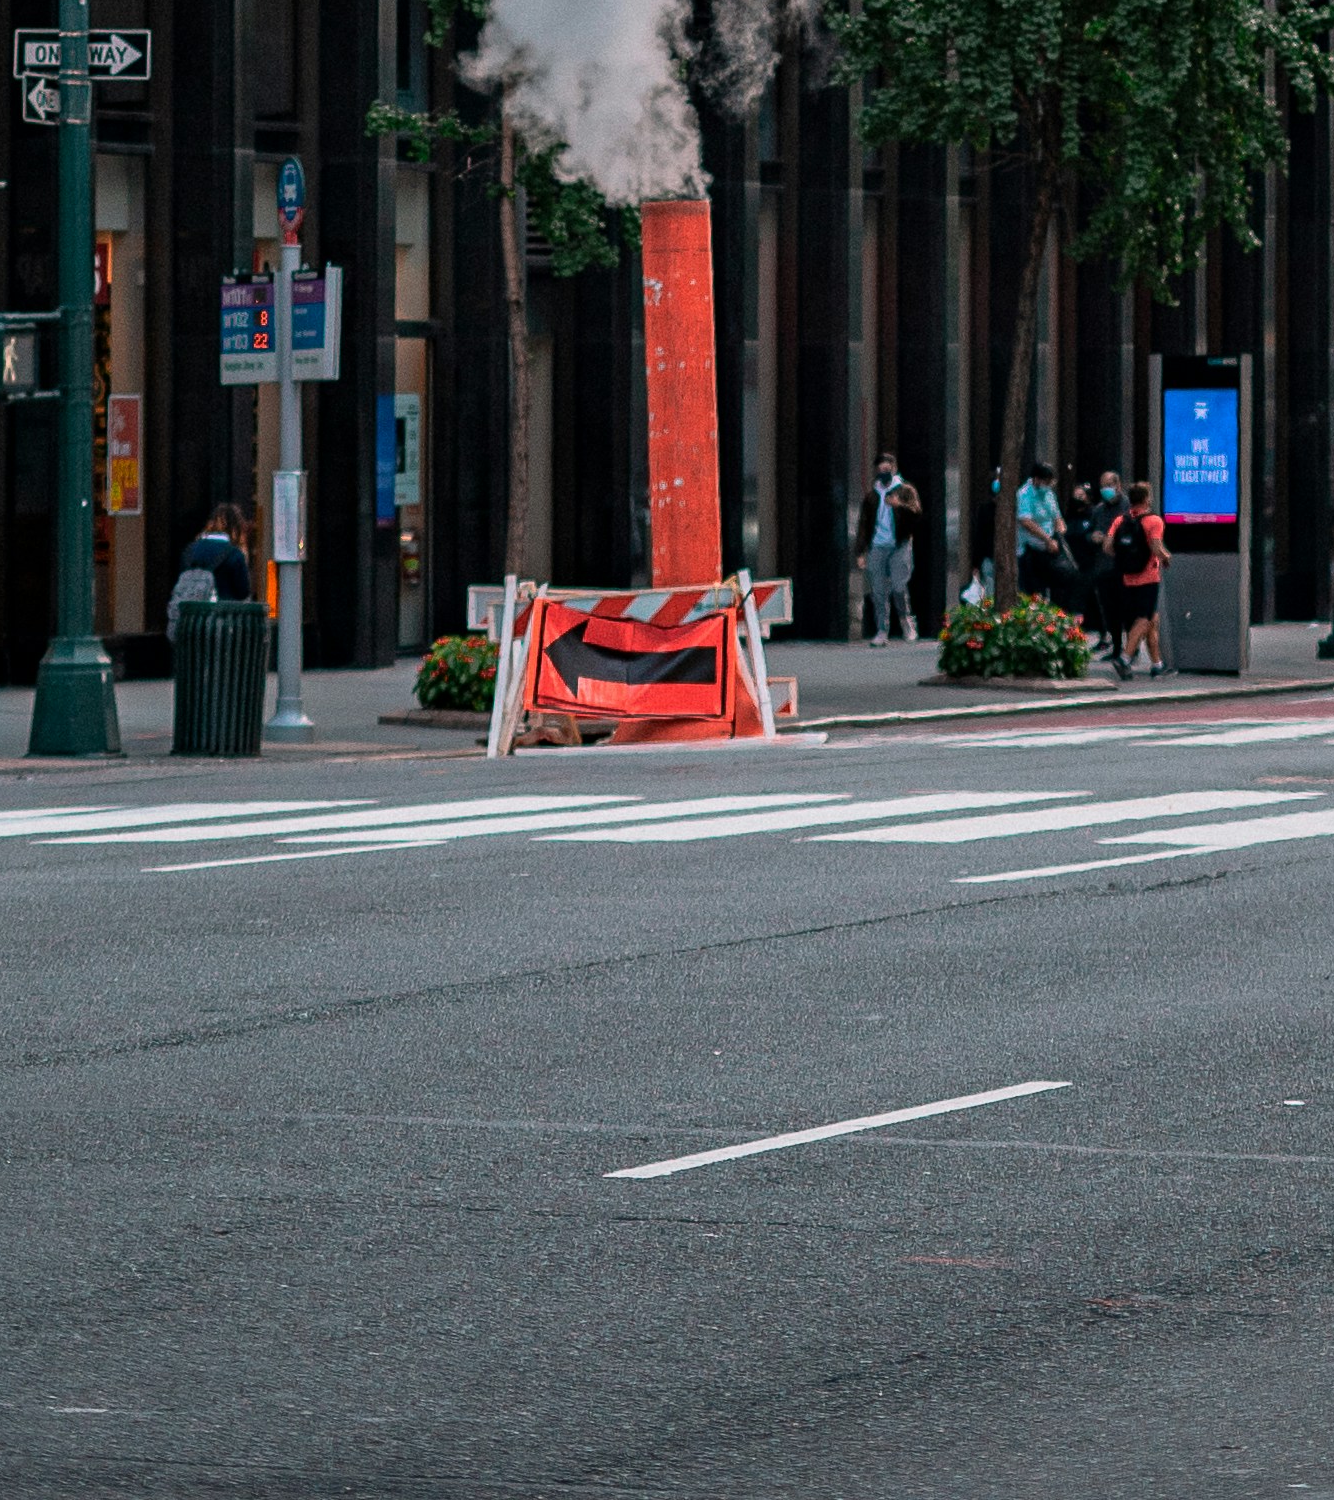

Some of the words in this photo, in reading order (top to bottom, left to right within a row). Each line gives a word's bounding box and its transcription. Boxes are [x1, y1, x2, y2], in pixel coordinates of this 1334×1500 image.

[34, 45, 61, 63] ON
[88, 45, 128, 63] WAY
[260, 310, 268, 327] 8
[253, 333, 269, 349] 22
